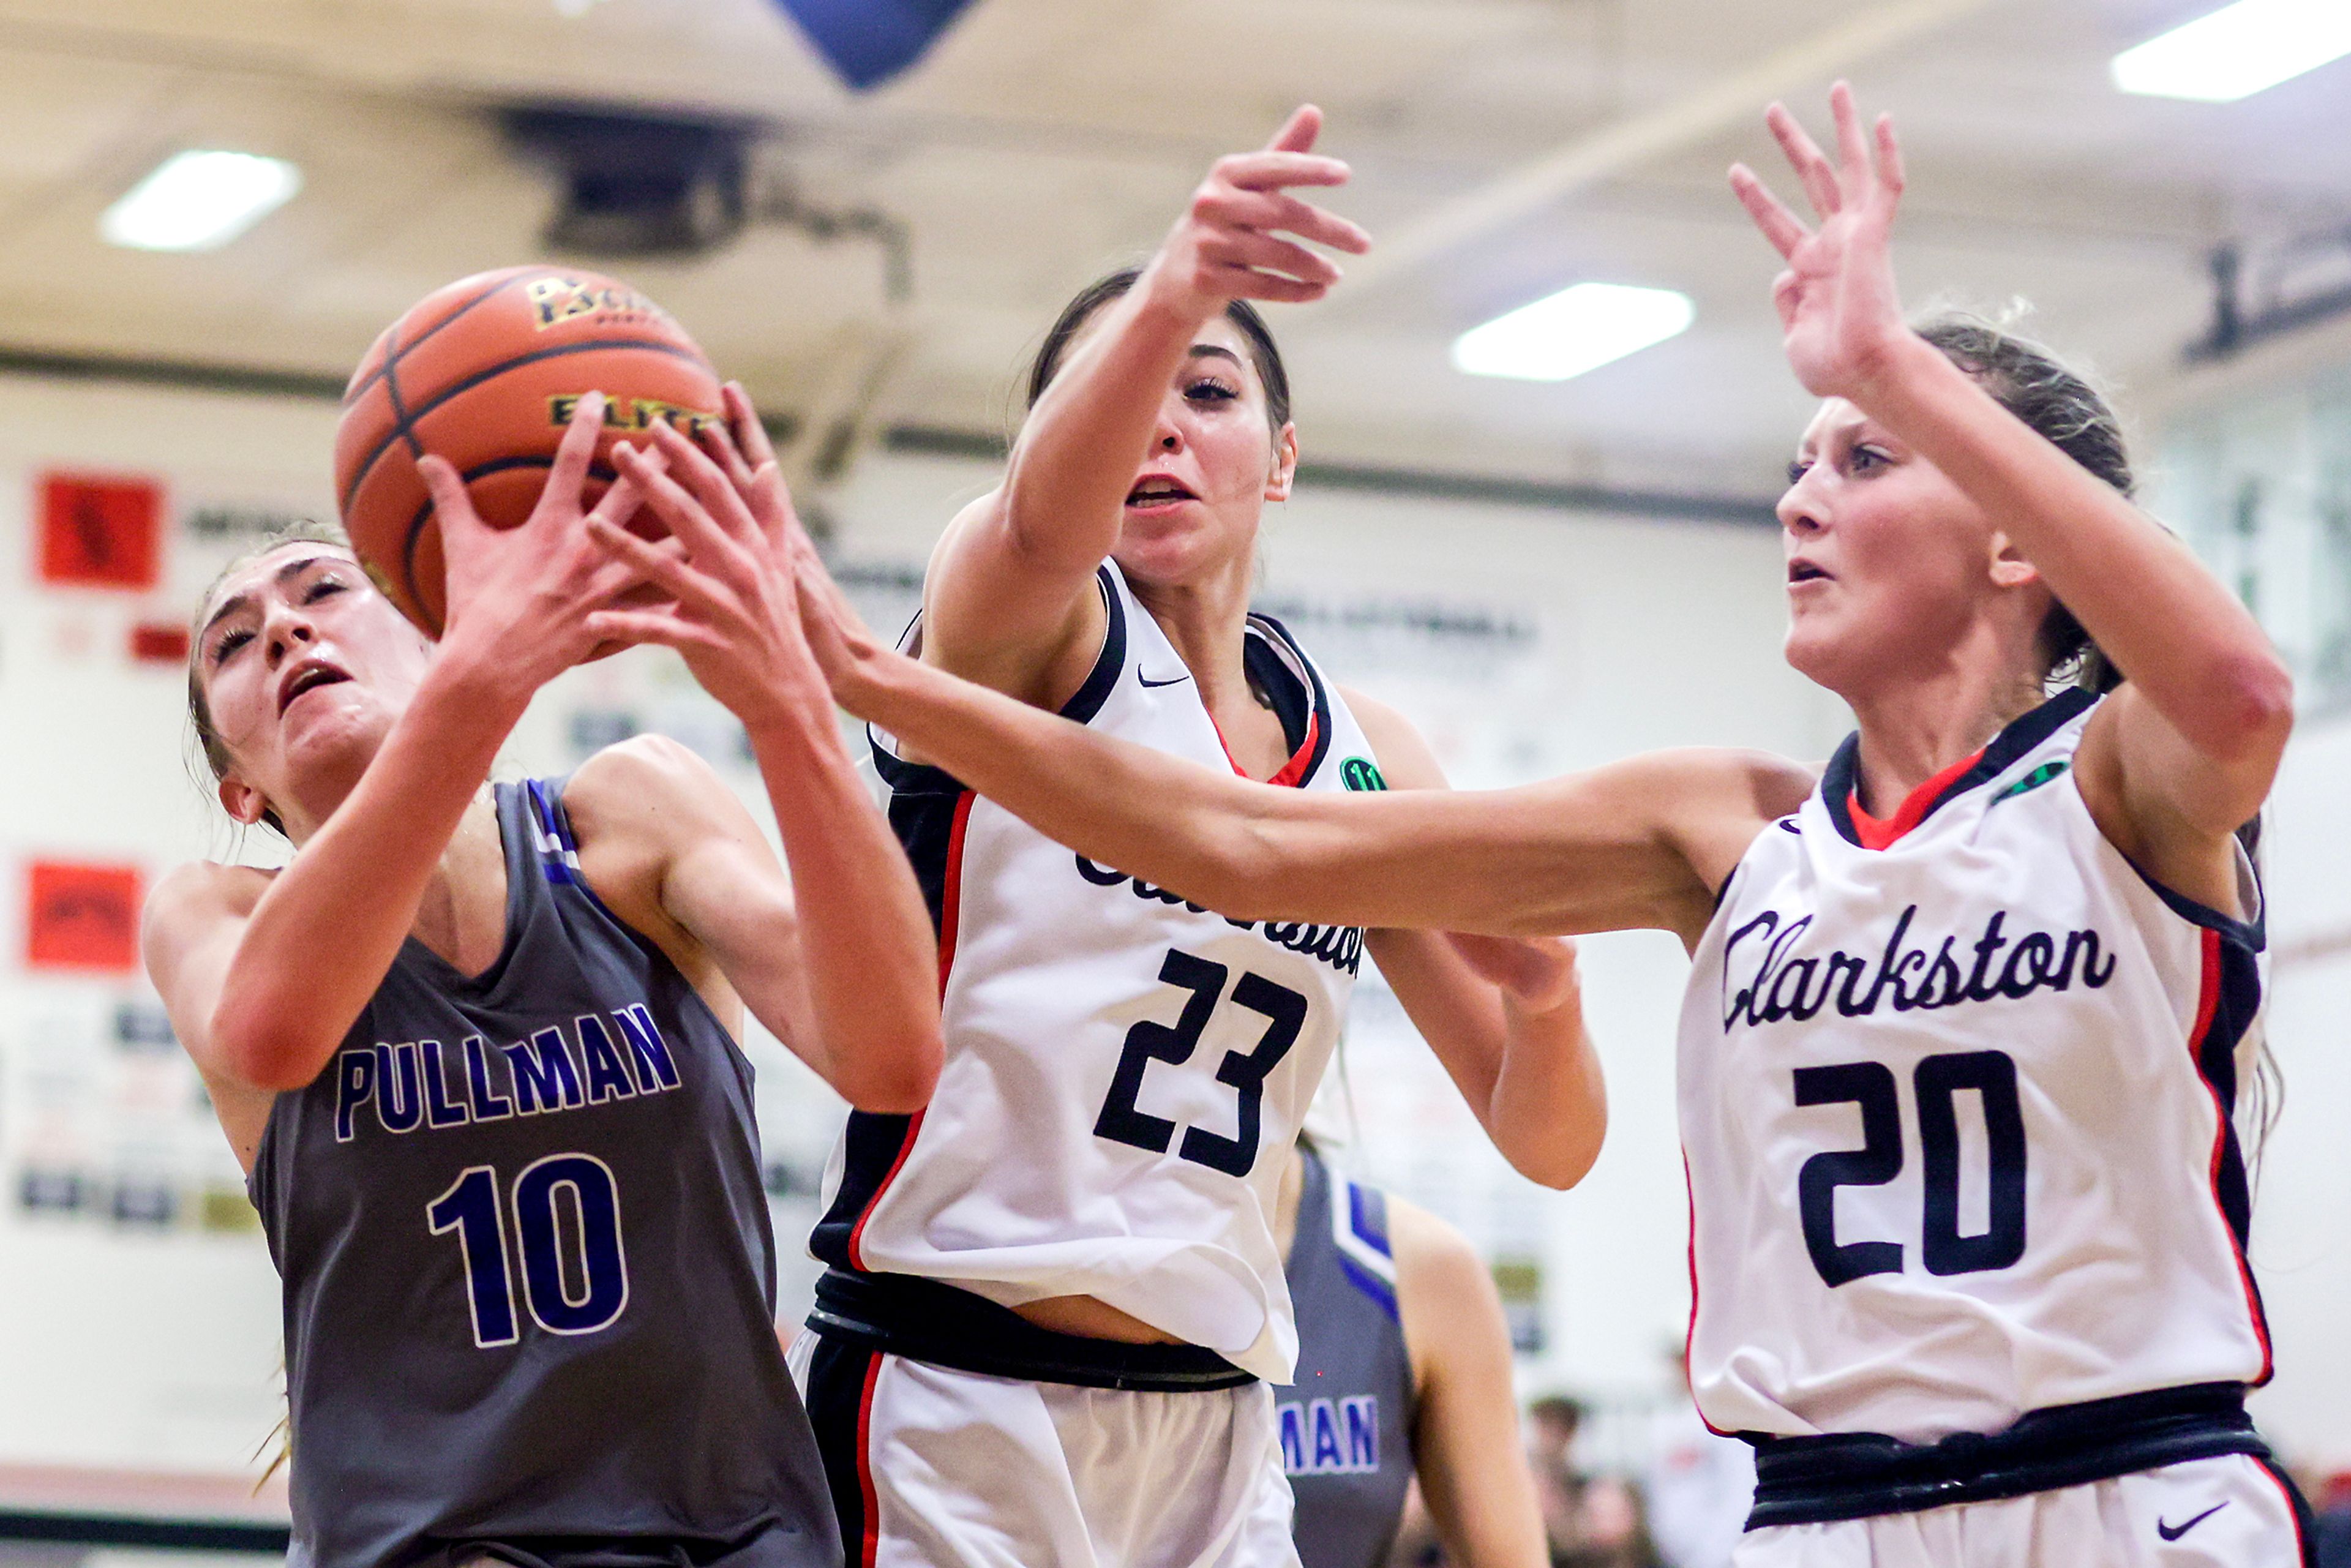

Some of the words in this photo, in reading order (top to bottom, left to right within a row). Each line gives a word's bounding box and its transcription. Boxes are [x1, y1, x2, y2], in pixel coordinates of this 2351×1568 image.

[1093, 947, 1308, 1178] 23
[1722, 904, 2117, 1035] Clarkston
[336, 1002, 681, 1143] PULLMAN
[1793, 1049, 2027, 1289] 20
[426, 1152, 629, 1349] 10
